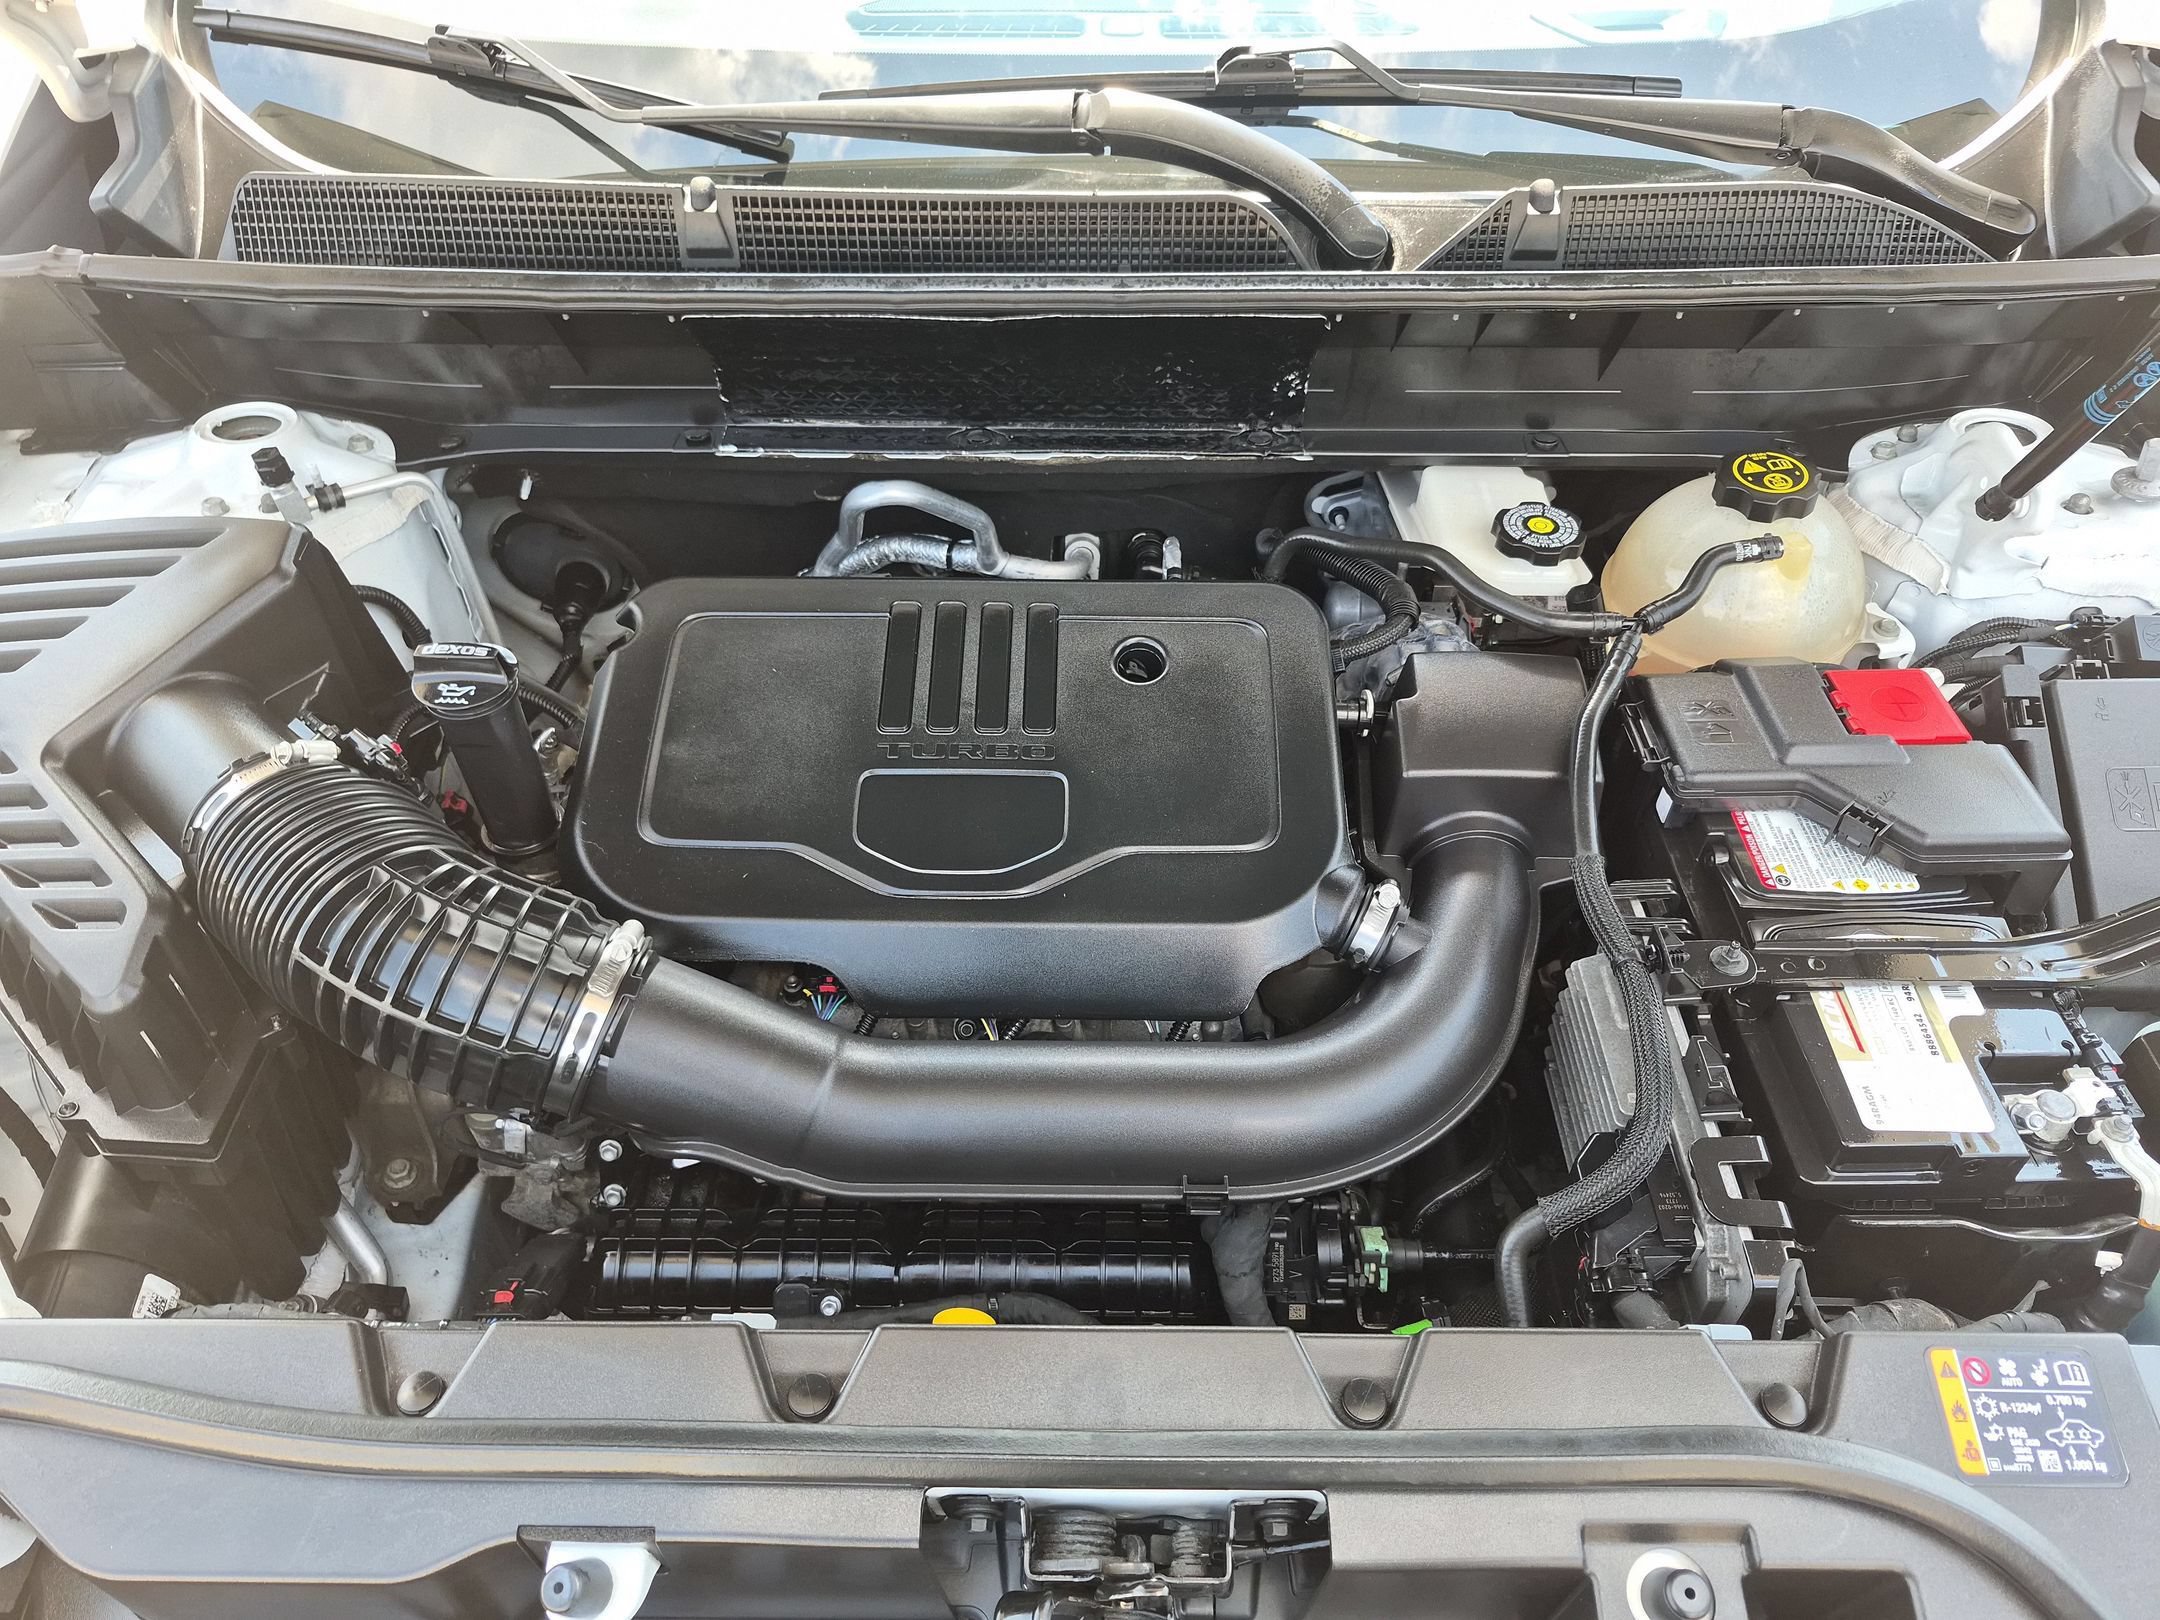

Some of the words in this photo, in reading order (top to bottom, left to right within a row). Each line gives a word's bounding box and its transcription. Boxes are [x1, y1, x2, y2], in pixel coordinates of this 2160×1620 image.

[421, 643, 489, 657] dexos
[876, 742, 1056, 761] TURBO
[1913, 1012, 1940, 1056] 88864542
[1862, 1085, 1885, 1125] 94RAGM
[2001, 1377, 2023, 1387] AUTO
